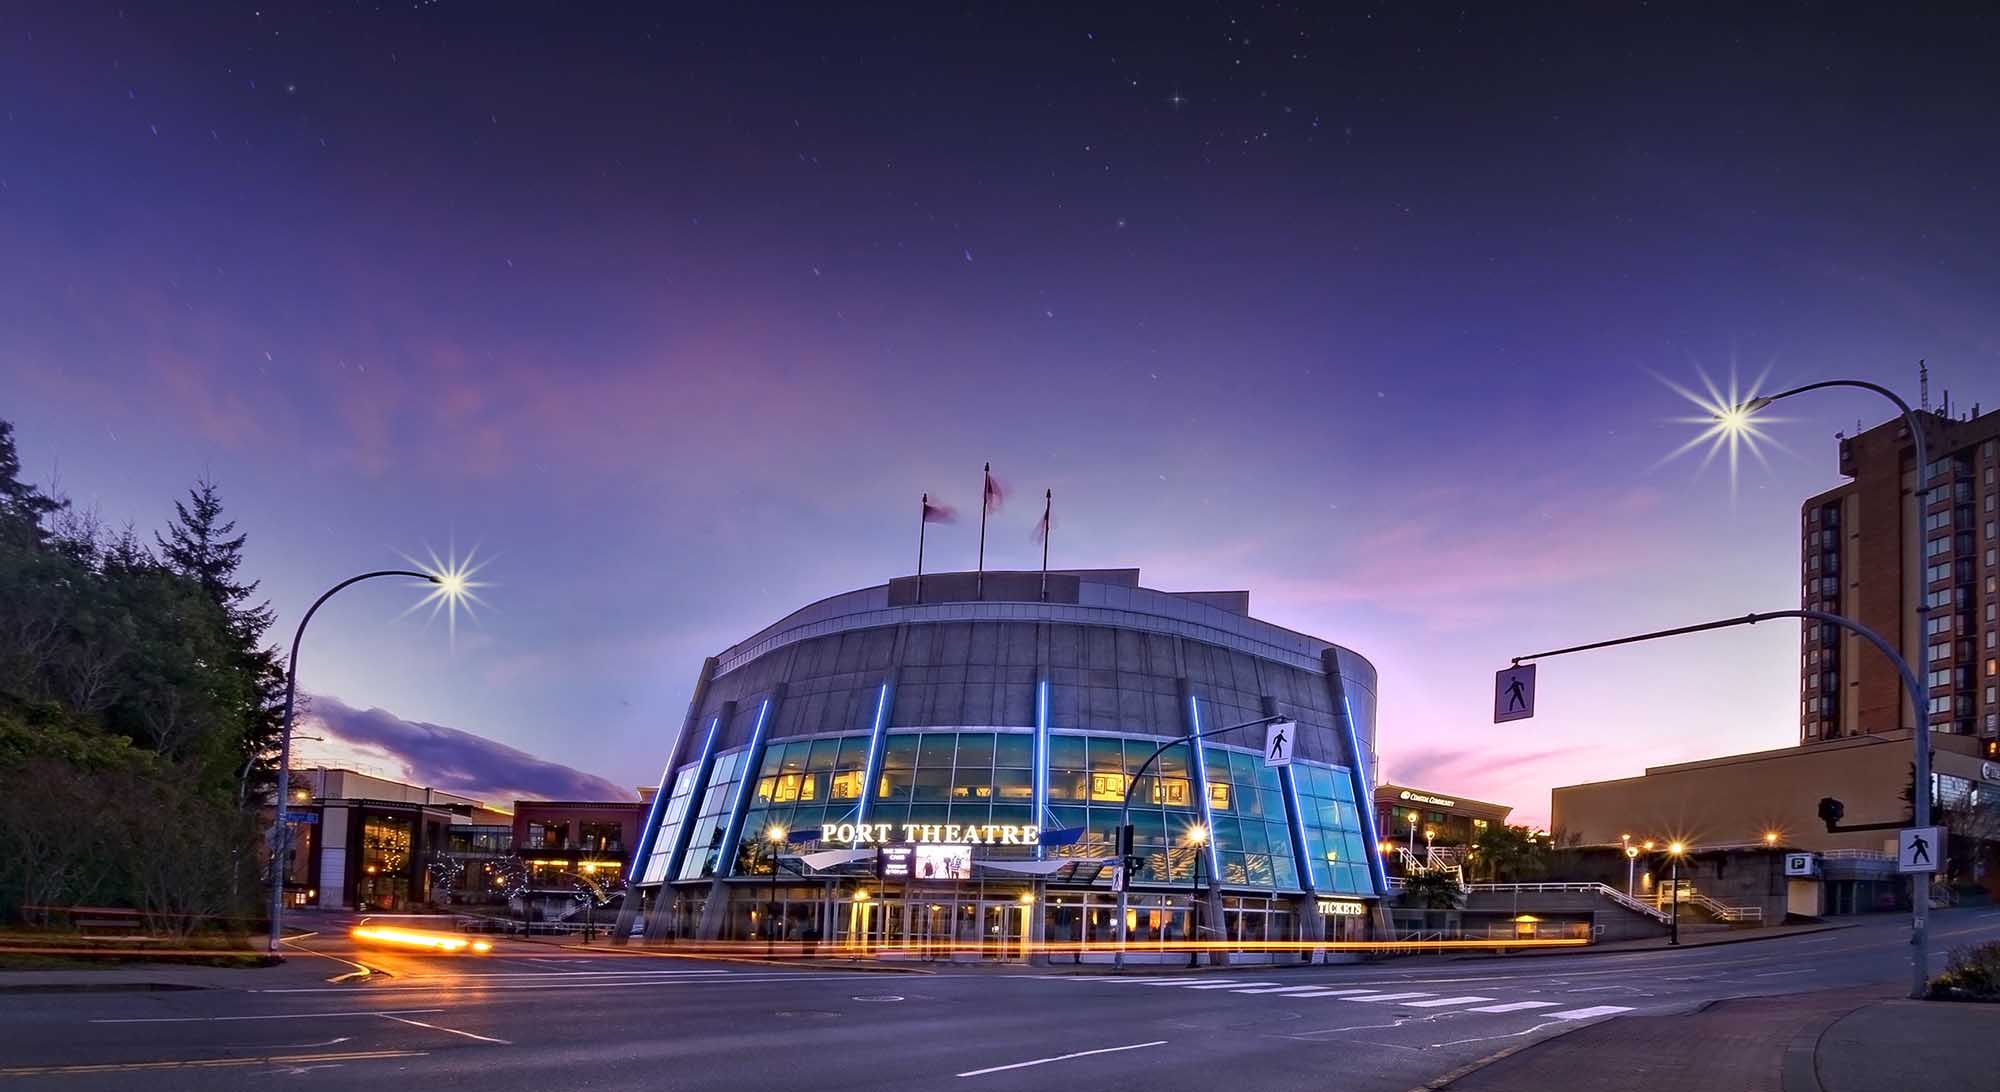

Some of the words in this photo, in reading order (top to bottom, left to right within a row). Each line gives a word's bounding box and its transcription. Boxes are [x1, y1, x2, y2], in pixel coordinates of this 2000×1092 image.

[821, 823, 892, 843] PORT
[902, 824, 1040, 845] THEATRE
[1317, 901, 1362, 915] TICKETS
